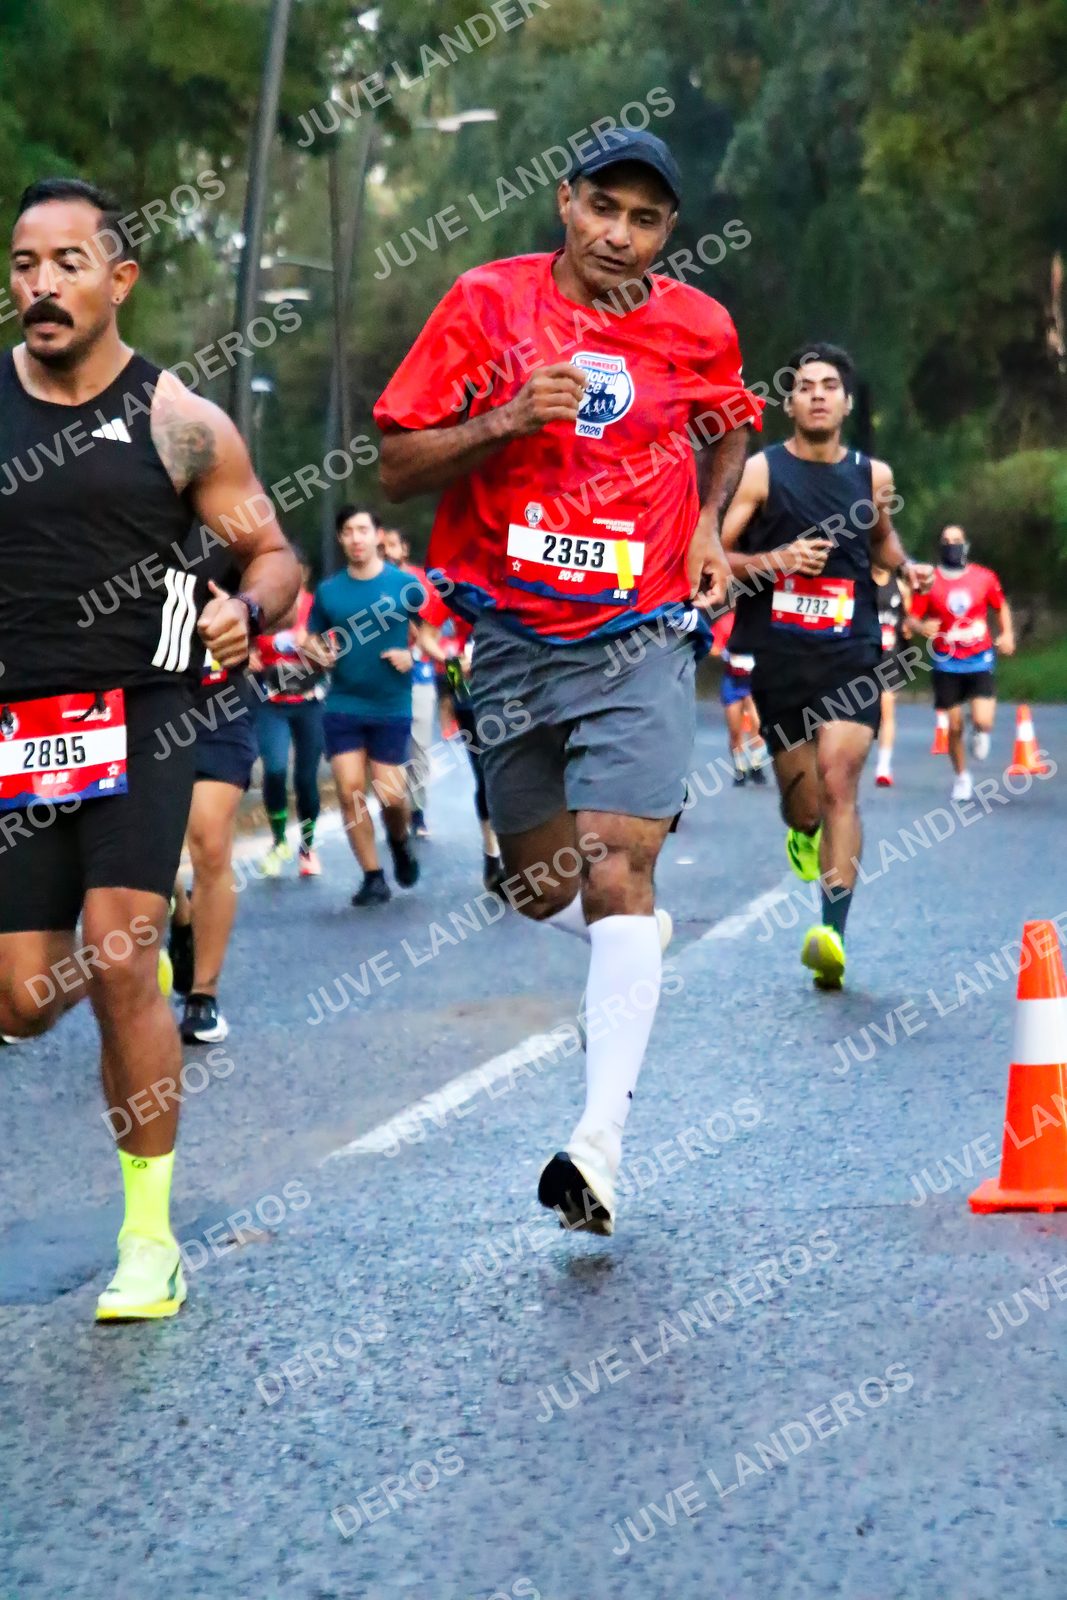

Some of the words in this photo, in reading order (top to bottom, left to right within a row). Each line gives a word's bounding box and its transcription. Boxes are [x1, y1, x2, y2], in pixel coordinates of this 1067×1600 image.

[578, 424, 601, 436] 2026
[541, 534, 605, 568] 2353
[795, 597, 829, 615] 2732
[23, 735, 86, 769] 2895
